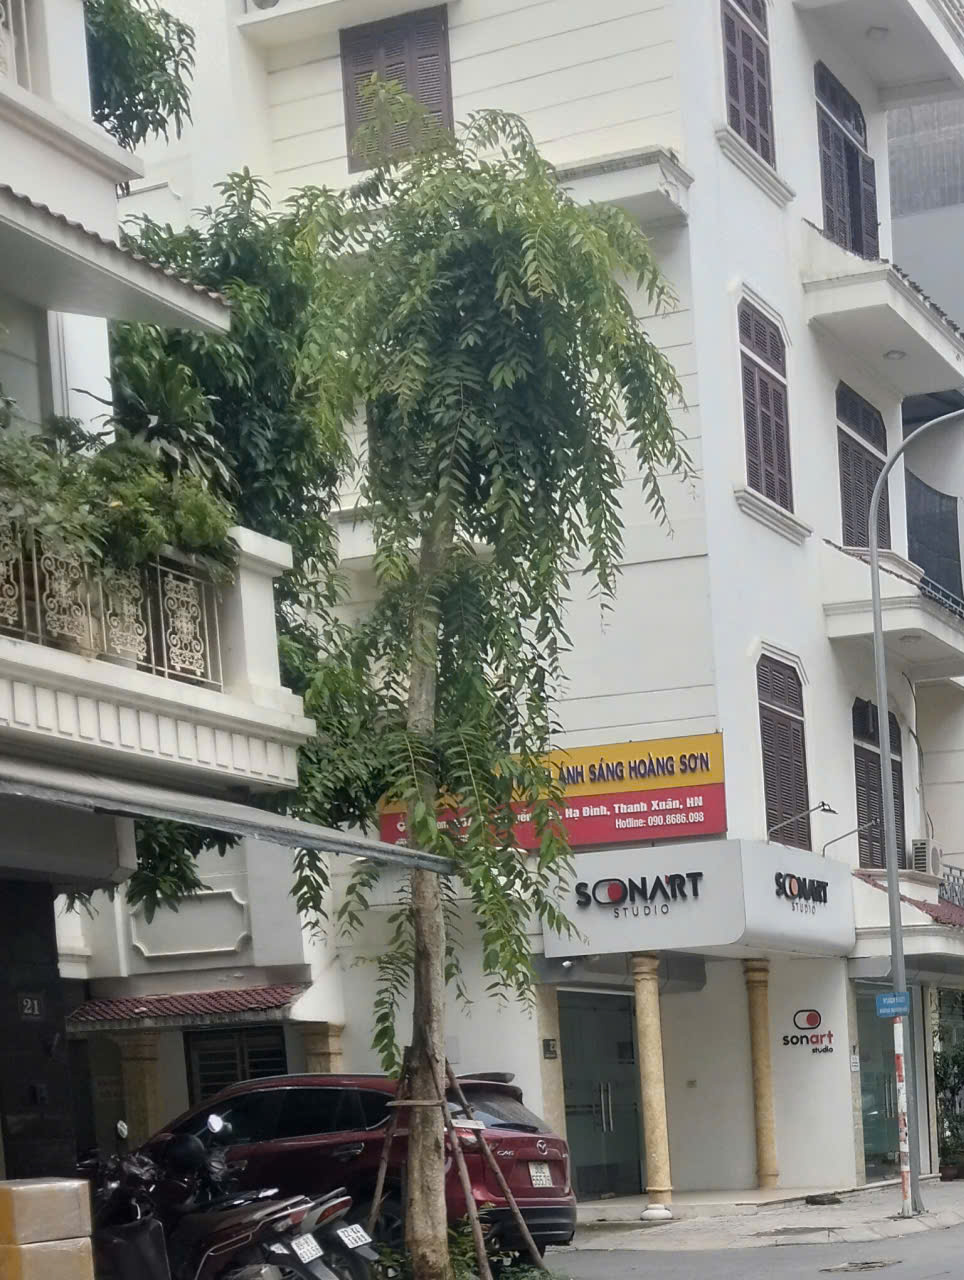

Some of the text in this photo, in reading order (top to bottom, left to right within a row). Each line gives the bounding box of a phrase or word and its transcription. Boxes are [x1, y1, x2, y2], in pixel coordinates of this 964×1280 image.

[589, 757, 624, 783] SÁNG
[629, 753, 675, 779] HOÀNG
[680, 751, 710, 773] SƠN
[565, 808, 580, 820] Hạ
[614, 801, 648, 814] Thanh
[651, 798, 683, 811] Xuân,
[686, 796, 704, 807] HN
[616, 812, 705, 829] Hotline: 090.8686.098
[613, 903, 670, 919] STUDIO
[791, 901, 817, 915] STUDIO
[23, 998, 41, 1015] 21
[782, 1030, 834, 1046] sonart
[811, 1046, 834, 1054] studio
